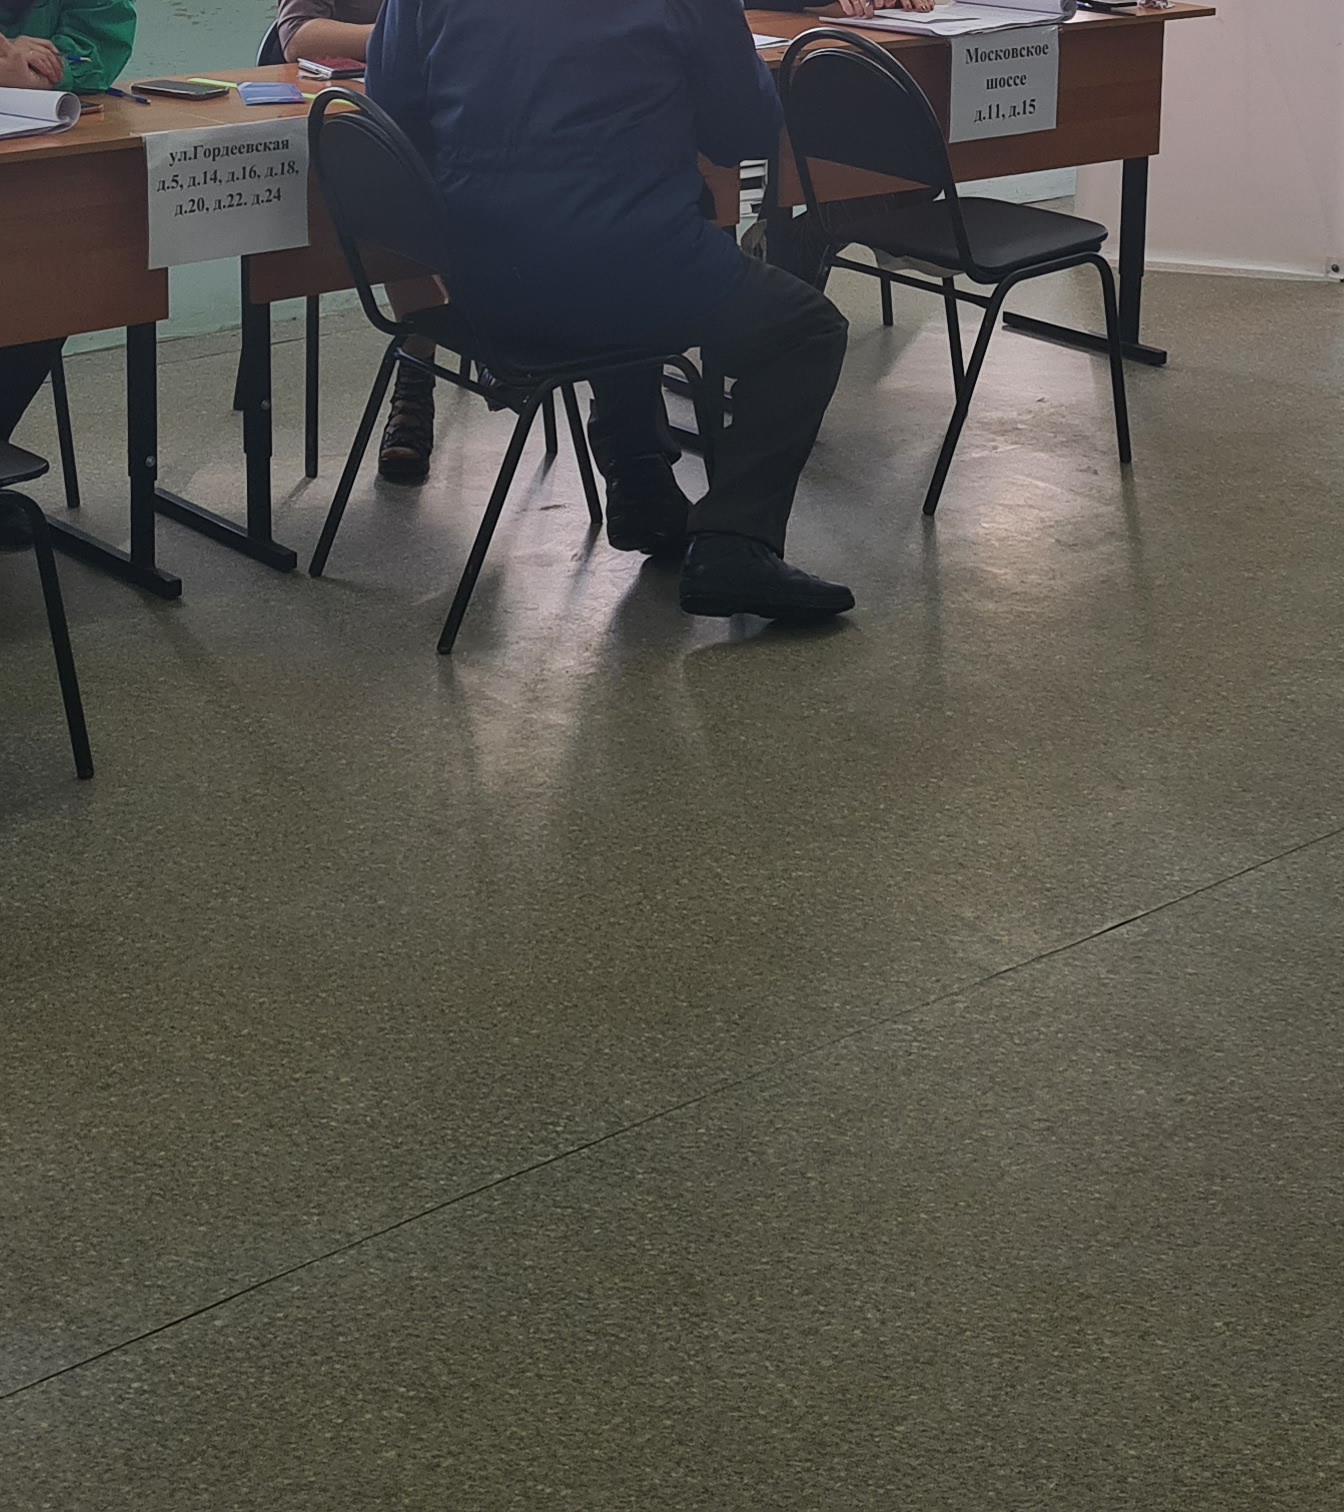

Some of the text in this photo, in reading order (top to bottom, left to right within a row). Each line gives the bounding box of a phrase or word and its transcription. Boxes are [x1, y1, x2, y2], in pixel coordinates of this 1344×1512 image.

[965, 43, 1049, 65] Московское
[986, 74, 1027, 90] шоссе
[974, 99, 1036, 123] д.11, д.15
[168, 138, 289, 167] ул.Гордеевская
[156, 160, 299, 193] д.5, д.14, д.16, д.18,
[174, 197, 209, 217] д.20,
[251, 187, 282, 207] д.24
